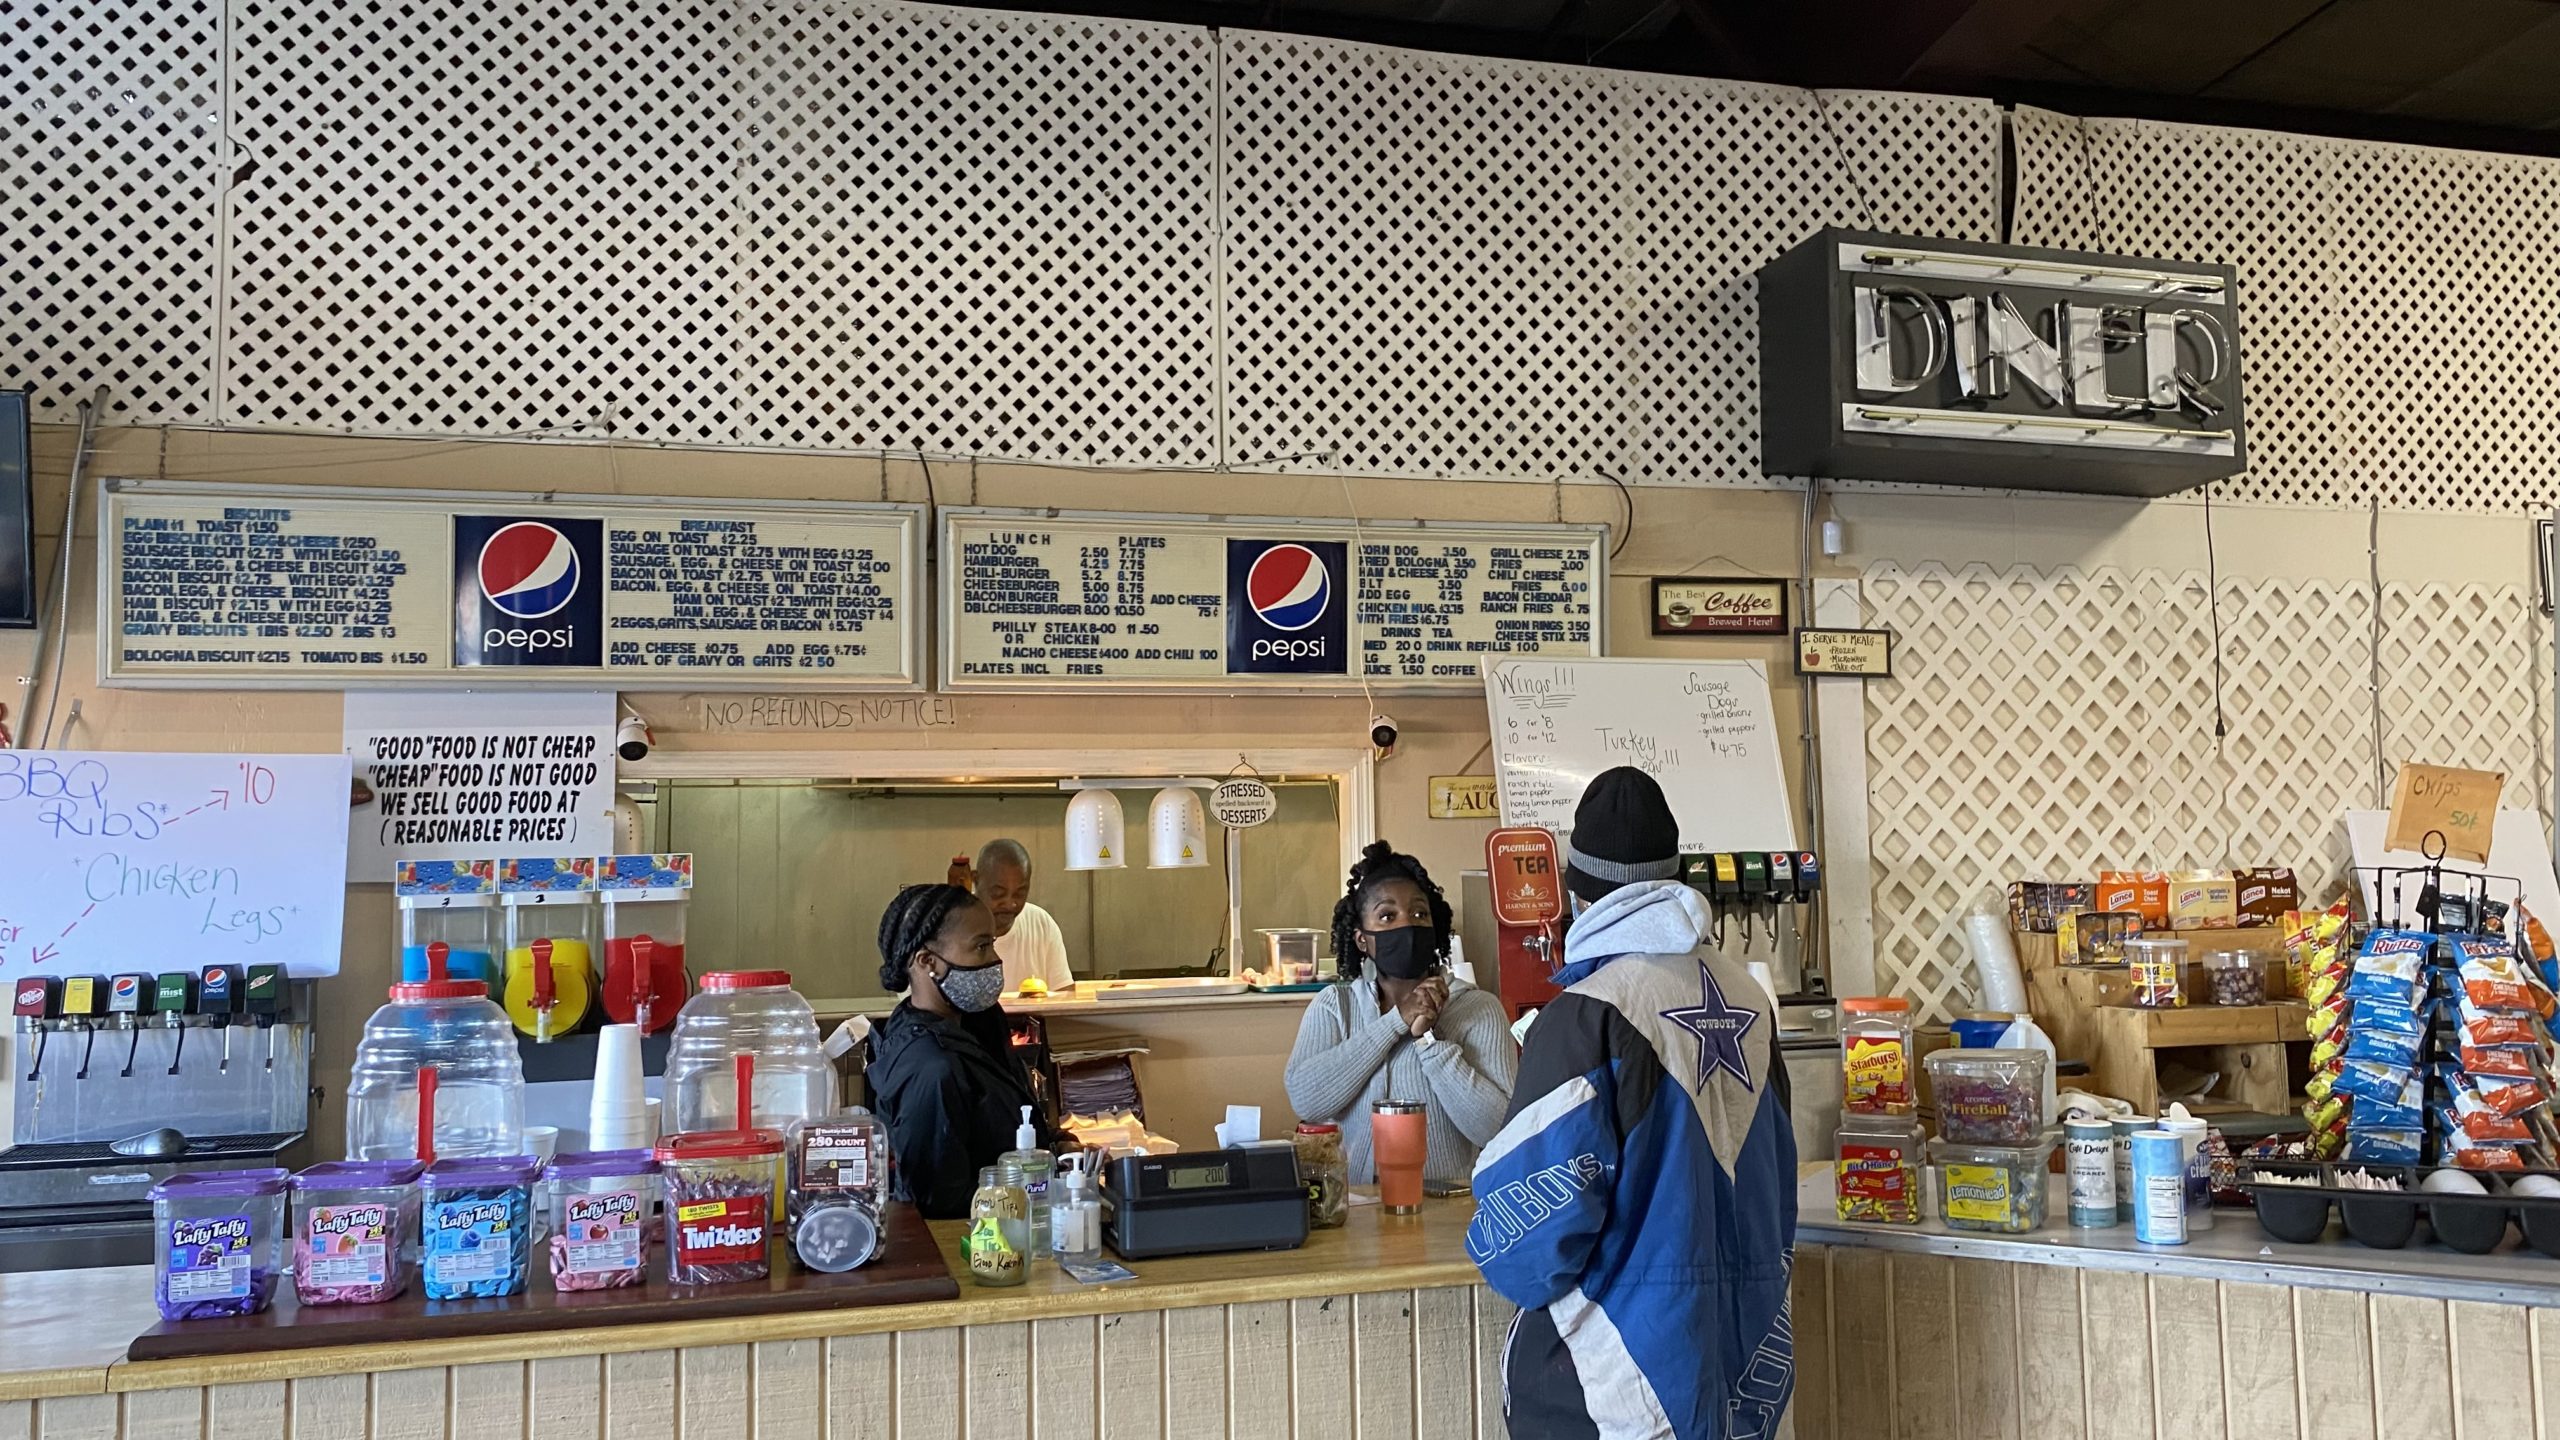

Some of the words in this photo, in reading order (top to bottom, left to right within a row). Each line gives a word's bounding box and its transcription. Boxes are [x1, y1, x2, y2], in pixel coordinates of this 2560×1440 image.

[1855, 284, 2232, 416] DINER
[224, 508, 290, 520] BISCUITS
[681, 521, 755, 533] BREAKFAST
[610, 530, 636, 542] EGG
[643, 531, 660, 542] ON
[668, 532, 709, 543] TOAST
[721, 534, 757, 545] $2.25
[964, 544, 991, 554] HOT
[992, 545, 1016, 554] DOG
[1081, 547, 1108, 558] 2.50
[1120, 548, 1145, 558] 7.75
[1491, 548, 1520, 558] GRILL
[1523, 549, 1563, 559] CHEESE
[1567, 550, 1589, 559] 2.75
[964, 556, 1039, 567] HAMBURGER
[1080, 559, 1109, 569] 4.25
[1119, 560, 1144, 570] 7.75
[1491, 560, 1521, 569] FRIES
[123, 572, 172, 583] BACON
[178, 573, 232, 584] BISCUIT
[289, 575, 324, 586] WITH
[331, 576, 356, 586] EGG
[610, 568, 655, 579] BACON
[659, 569, 677, 580] ON
[683, 570, 723, 581] TOAST
[729, 571, 763, 581] $2.75
[773, 572, 804, 582] WITH
[810, 573, 836, 583] EGG
[964, 580, 1059, 591] CHEESEBURGER
[1083, 583, 1109, 592] 5.00
[1117, 583, 1144, 593] 8.75
[1663, 590, 1681, 599] The
[1687, 590, 1705, 599] Best
[1481, 603, 1517, 613] RANCH
[1523, 604, 1553, 613] FRIES
[1564, 604, 1589, 614] 6.75
[1705, 592, 1772, 613] Coffee
[1708, 618, 1742, 626] Brewed
[1748, 618, 1773, 626] Here!
[484, 624, 573, 653] pepsi
[1044, 635, 1099, 644] CHICKEN
[1381, 628, 1421, 637] DRINKS
[1432, 628, 1453, 638] TEA
[1813, 634, 1837, 644] SERVE
[610, 643, 639, 653] ADD
[646, 643, 696, 653] CHEESE
[766, 644, 794, 654] ADD
[803, 644, 829, 655] EGG
[1252, 636, 1325, 661] pepsi
[1427, 642, 1461, 651] DRINK
[1467, 642, 1511, 651] REFILLS
[610, 655, 648, 665] BOWL
[655, 655, 671, 665] OF
[678, 656, 722, 666] GRAVY
[727, 656, 744, 666] OR
[753, 657, 792, 666] GRITS
[964, 663, 1014, 673] PLATES
[1022, 664, 1049, 674] INCL
[1067, 664, 1103, 674] FRIES
[1432, 665, 1475, 675] COFFEE
[1684, 672, 1730, 696] Sausage
[1708, 695, 1739, 710] Dogs
[706, 702, 743, 730] NO
[751, 697, 853, 728] REFUNDS
[861, 698, 955, 726] NOTICE!
[1508, 718, 1517, 728] 6
[1509, 734, 1518, 744] 10
[482, 736, 498, 758] IS
[503, 736, 537, 758] NOT
[543, 736, 595, 759] CHEAP
[439, 764, 483, 787] FOOD
[489, 764, 505, 786] IS
[510, 763, 544, 786] NOT
[550, 763, 597, 786] GOOD
[1221, 784, 1265, 798] STRESSED
[381, 792, 407, 815] WE
[411, 792, 448, 815] SELL
[456, 791, 502, 814] GOOD
[509, 791, 552, 814] FOOD
[557, 790, 580, 813] AT
[1221, 808, 1266, 823] DESSERTS
[1498, 841, 1546, 856] premium
[1513, 856, 1549, 875] TEA
[86, 852, 238, 902] Chicken
[2110, 892, 2133, 904] Lance
[2181, 891, 2201, 903] Lance
[2242, 889, 2264, 901] Lance
[1696, 1018, 1736, 1030] COWBOYS
[1850, 1052, 1898, 1072] Starburst
[808, 1137, 833, 1146] 280
[571, 1204, 604, 1220] Laffy
[604, 1196, 634, 1212] Taffy
[314, 1217, 349, 1233] Laffy
[350, 1209, 381, 1226] Taffy
[440, 1212, 474, 1229] Laffy
[474, 1204, 505, 1220] Taffy
[174, 1229, 212, 1246] Laffy
[212, 1220, 246, 1237] Taffy
[683, 1224, 762, 1249] Twizzlers
